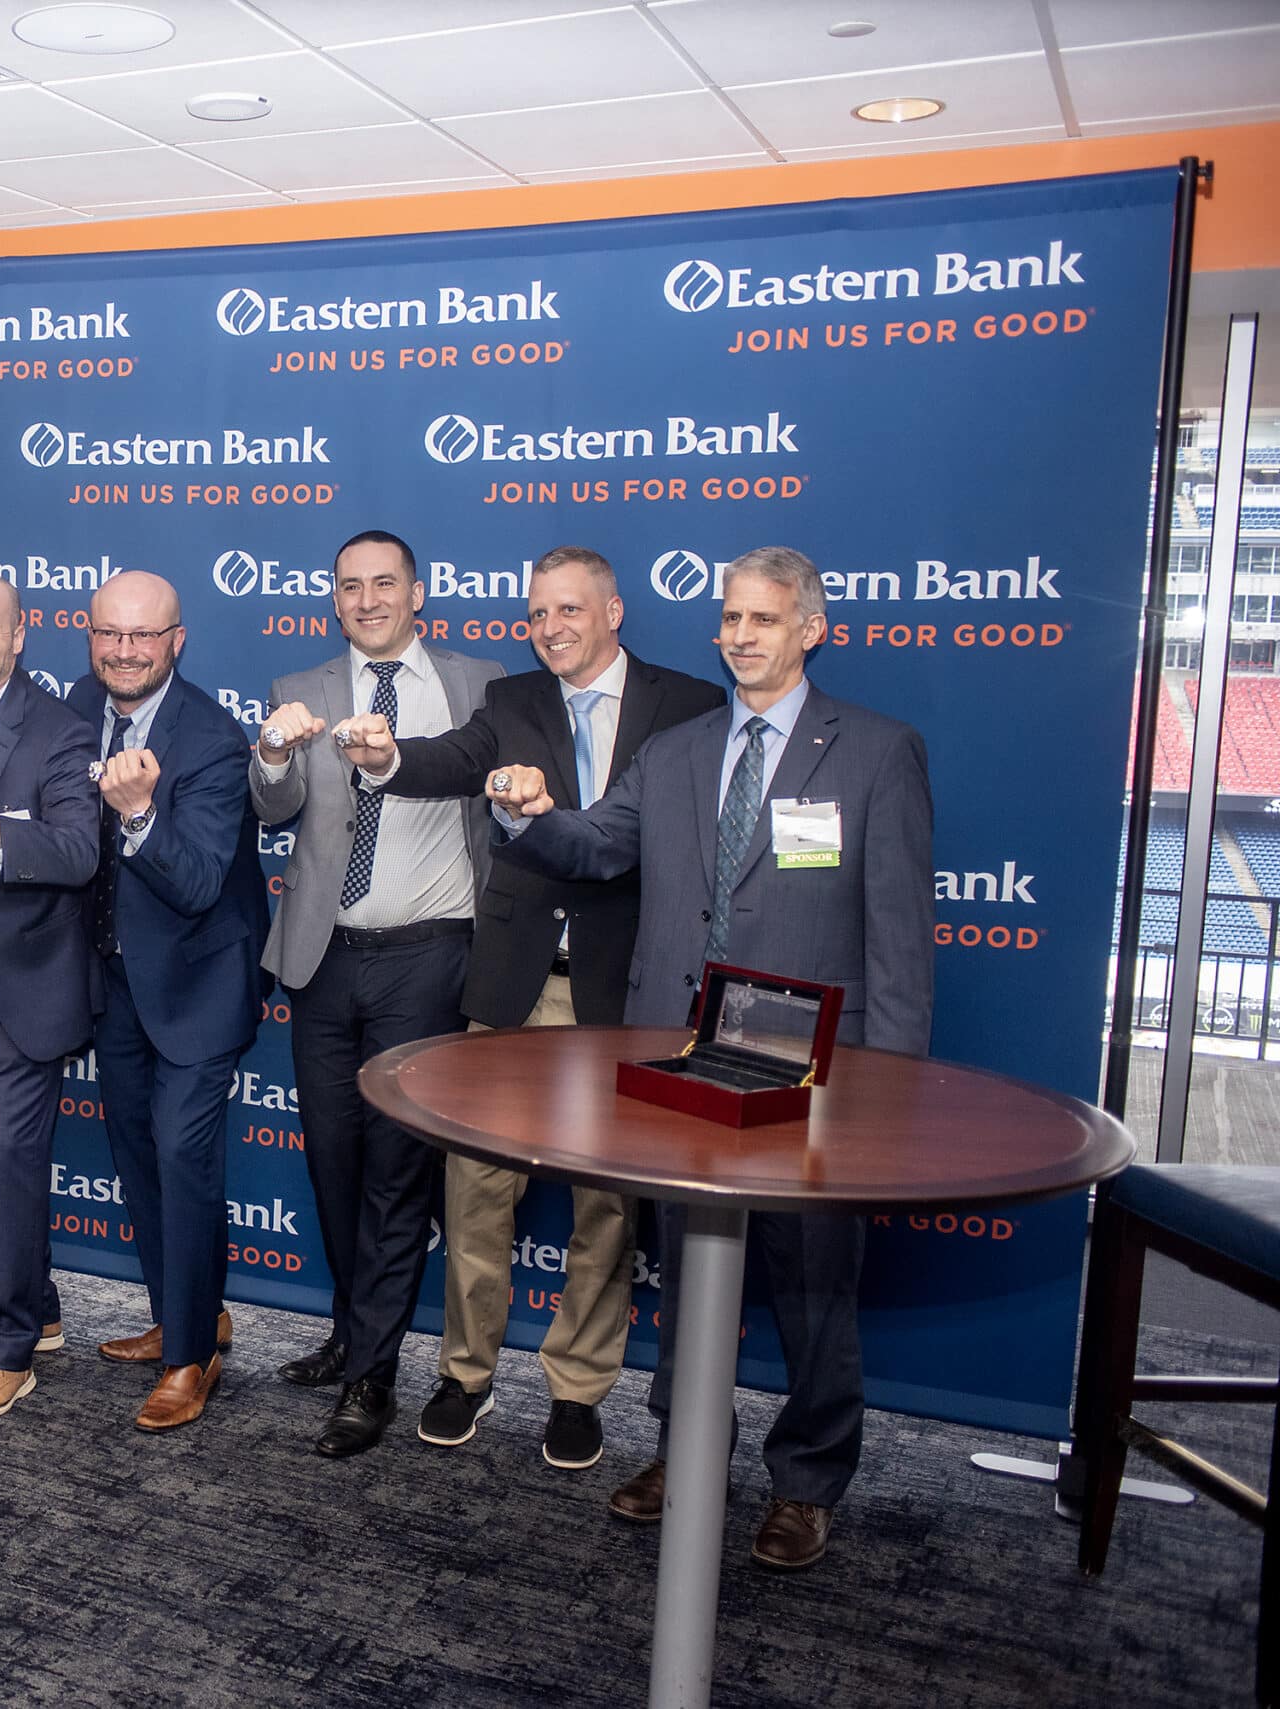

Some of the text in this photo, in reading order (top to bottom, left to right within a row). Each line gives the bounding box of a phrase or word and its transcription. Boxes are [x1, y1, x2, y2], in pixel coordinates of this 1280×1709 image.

[727, 241, 1084, 307] Eastern Bank
[31, 303, 129, 340] Bank
[269, 280, 560, 331] Eastern Bank
[729, 309, 1086, 352] JOIN US FOR GOOD
[0, 361, 46, 379] FOR
[58, 358, 133, 378] GOOD
[271, 342, 563, 372] JOIN US FOR GOOD
[68, 427, 330, 465] Eastern Bank
[482, 412, 798, 460] Eastern Bank
[69, 484, 333, 505] JOIN US FOR GOOD
[484, 477, 801, 503] JOIN US FOR GOOD
[27, 556, 122, 590] Bank
[914, 556, 1061, 599] Bank
[55, 610, 88, 628] GO
[263, 616, 530, 640] JOIN OR GOO
[867, 625, 936, 646] FOR
[954, 624, 1062, 646] GOOD
[935, 861, 1036, 903] ank
[243, 1126, 304, 1150] JOIN
[50, 1164, 123, 1204] East
[51, 1214, 107, 1237] JOIN
[227, 1199, 298, 1235] ank
